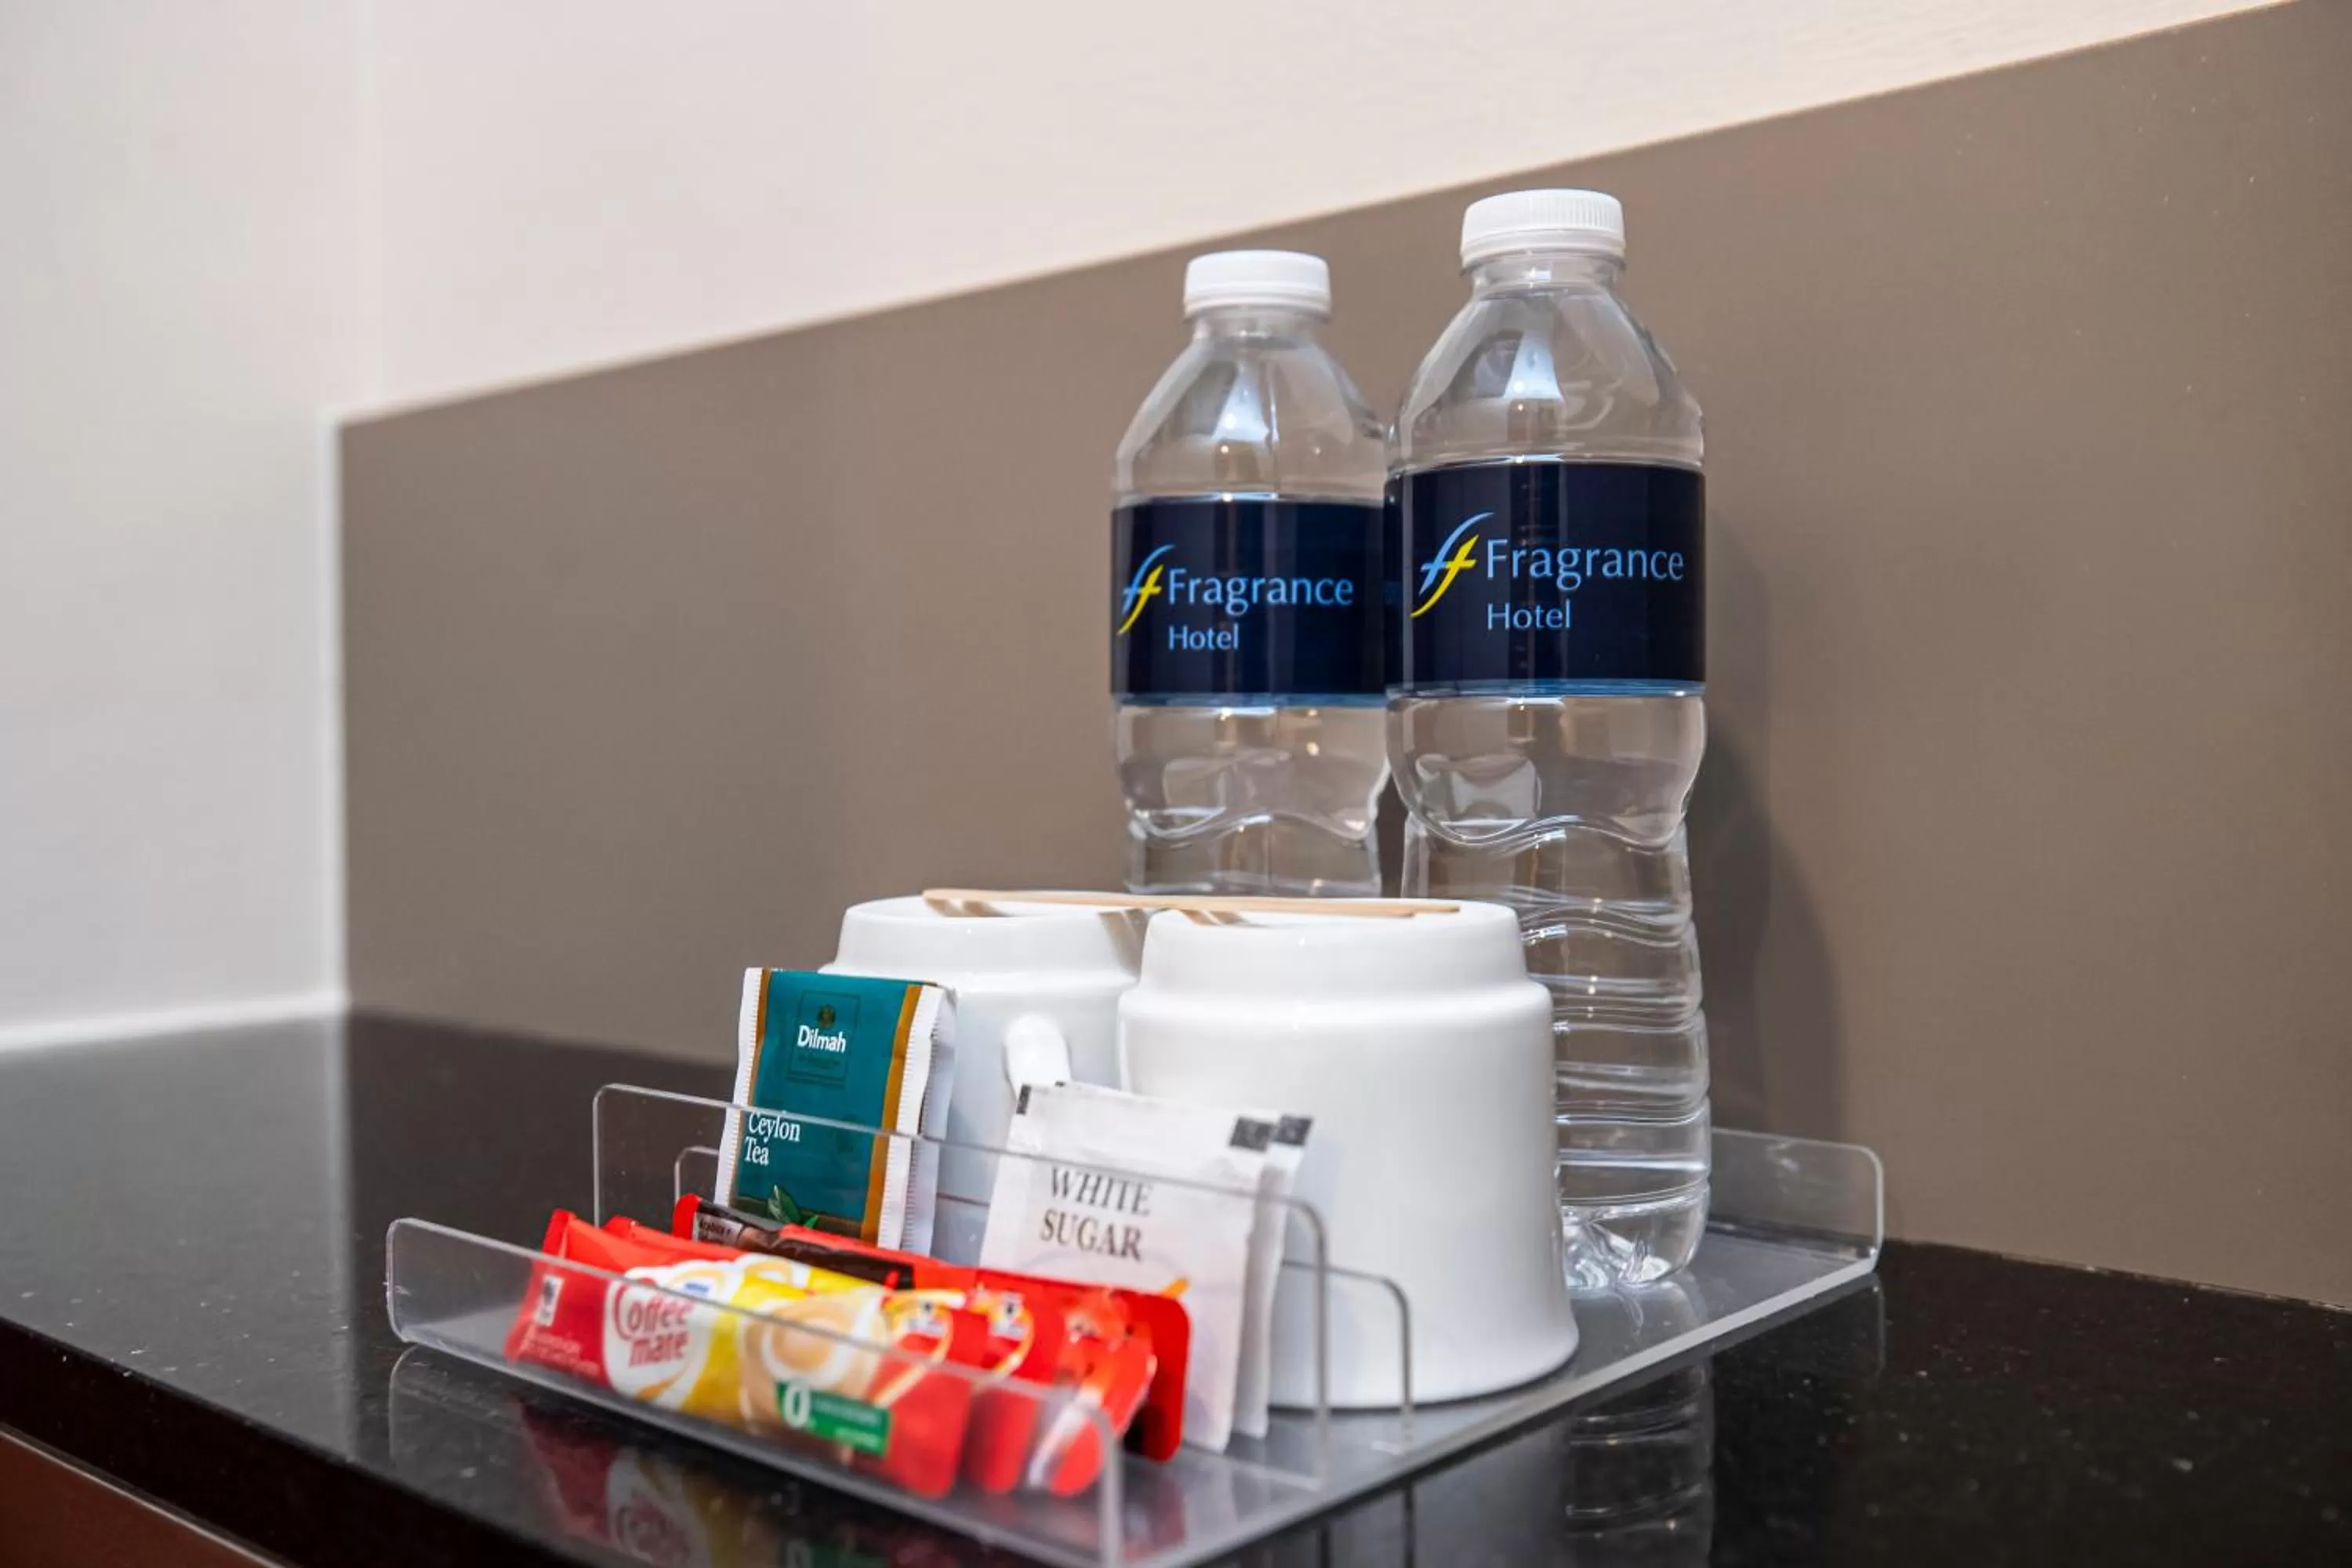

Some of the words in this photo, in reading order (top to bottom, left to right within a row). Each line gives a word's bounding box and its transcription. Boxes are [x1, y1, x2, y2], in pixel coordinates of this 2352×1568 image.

[1486, 539, 1685, 590] Fragrance
[1168, 568, 1354, 615] Fragrance
[1486, 601, 1571, 630] Hotel
[1168, 624, 1240, 651] Hotel
[797, 1024, 847, 1054] Dilmah
[748, 1111, 800, 1143] Ceylon
[744, 1137, 770, 1166] Tea
[1051, 1166, 1154, 1216] WHITE
[1040, 1207, 1144, 1261] SUGAR
[629, 1330, 688, 1367] mate
